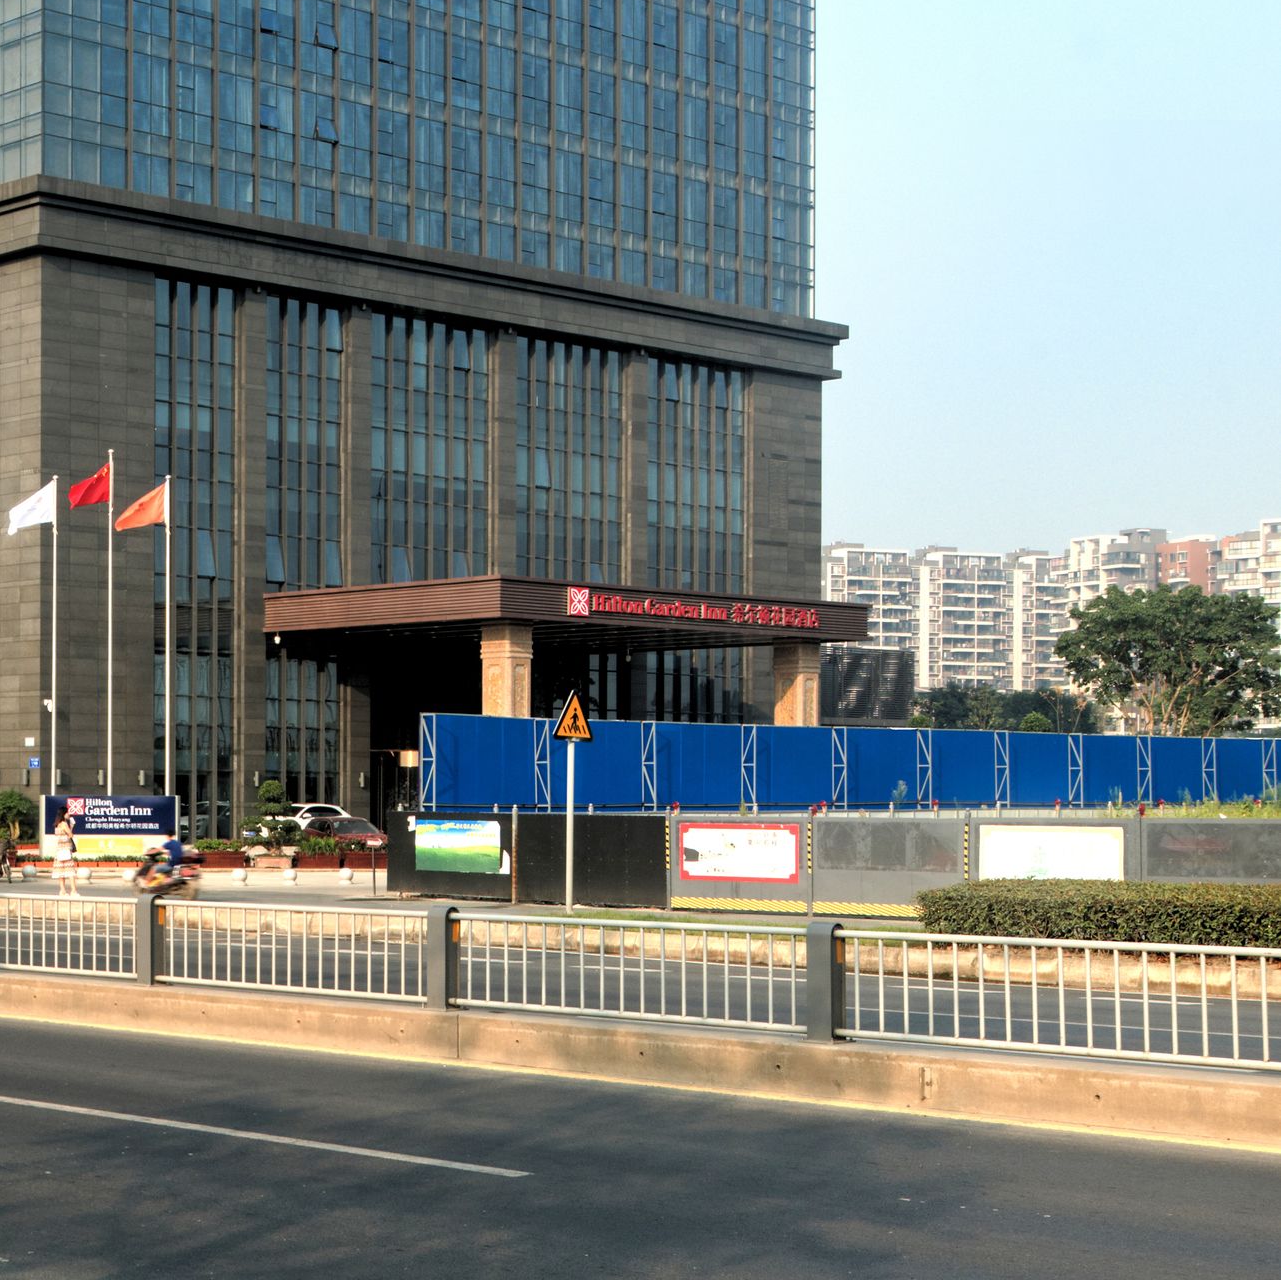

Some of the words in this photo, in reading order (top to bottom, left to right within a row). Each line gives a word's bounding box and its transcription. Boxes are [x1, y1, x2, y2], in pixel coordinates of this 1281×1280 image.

[592, 593, 643, 615] Hilton
[645, 598, 698, 619] Garden
[701, 603, 727, 620] Inn
[731, 602, 819, 628] 希尔顿花园酒店
[85, 798, 112, 806] Hilton
[85, 806, 129, 815] Garden
[130, 806, 151, 815] Inn
